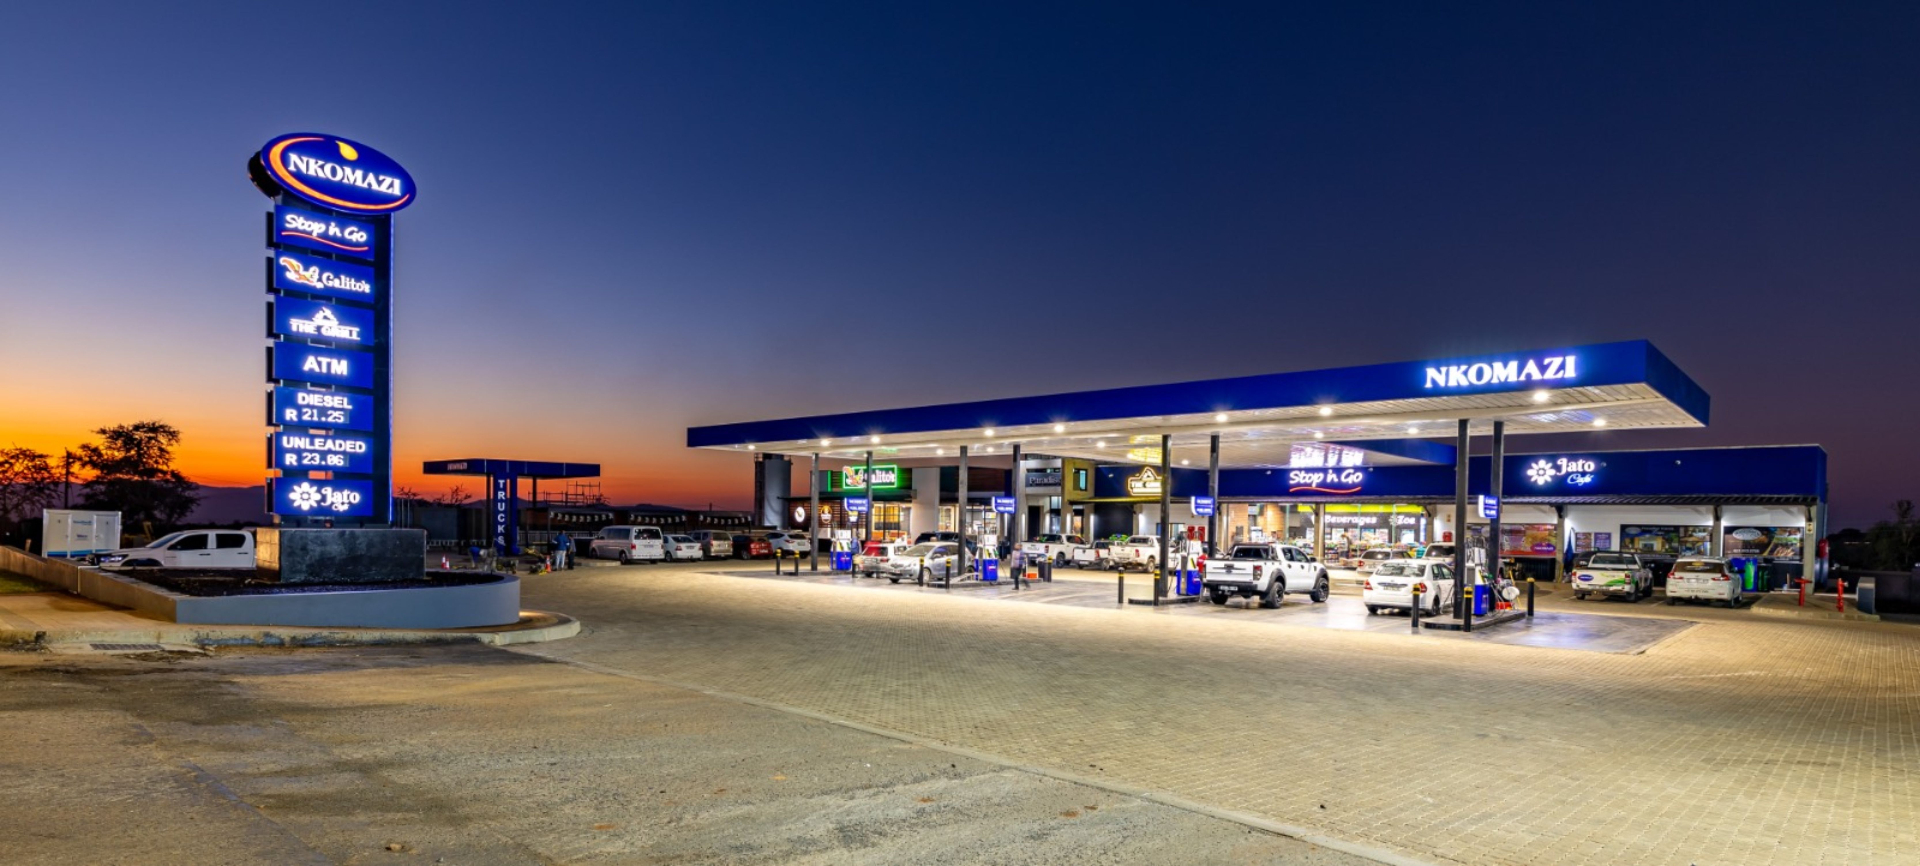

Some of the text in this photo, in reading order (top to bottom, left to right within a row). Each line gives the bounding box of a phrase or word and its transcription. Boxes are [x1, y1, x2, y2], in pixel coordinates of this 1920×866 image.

[288, 153, 401, 196] NKOMAZI
[285, 214, 326, 236] Stop
[344, 226, 367, 243] Go
[322, 272, 371, 293] Galito's
[290, 322, 318, 335] THE
[303, 356, 348, 376] ATM
[1424, 355, 1577, 389] NKOMAZI
[297, 393, 353, 409] DIESEL
[285, 408, 345, 422] R 21.25
[282, 436, 366, 453] UNLEADED
[285, 453, 298, 466] R
[1556, 457, 1596, 475] Jato
[1289, 470, 1324, 487] Stop
[1341, 468, 1363, 484] Go
[320, 486, 361, 506] Jato
[497, 479, 506, 547] TRUCKS
